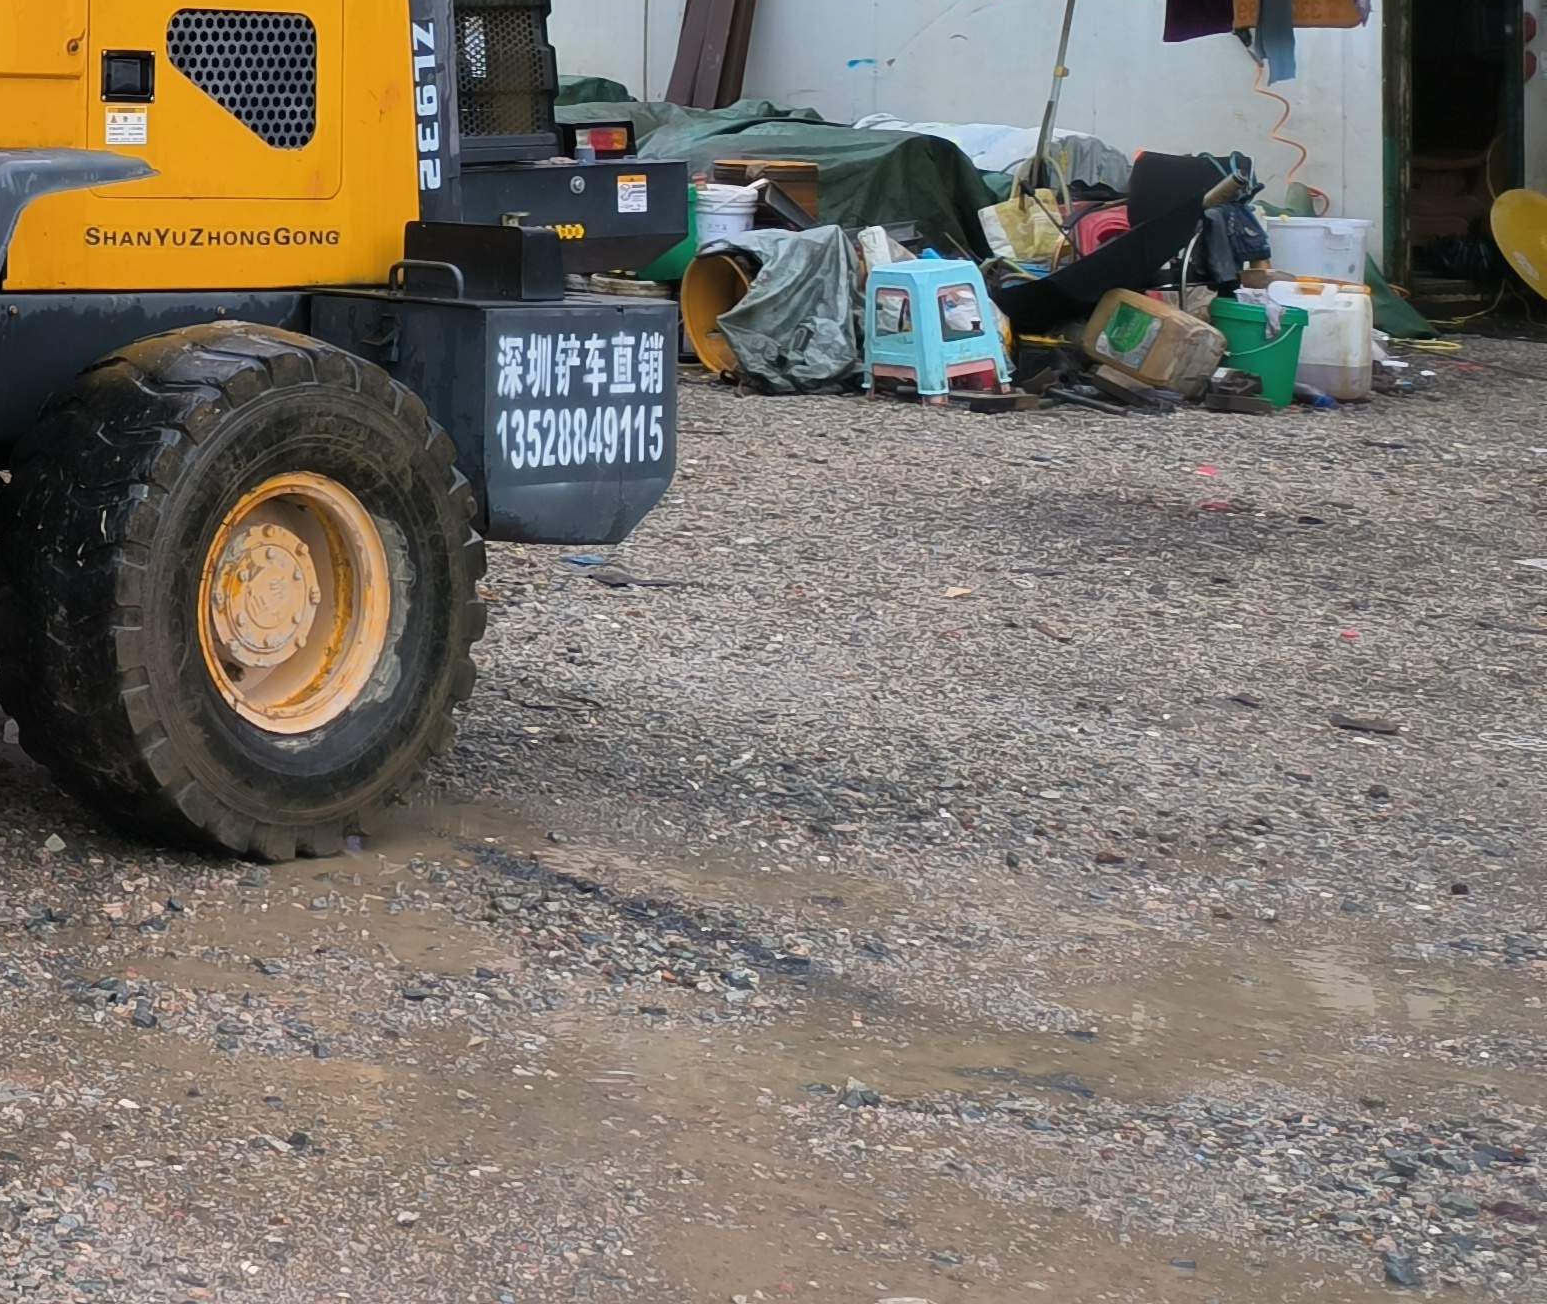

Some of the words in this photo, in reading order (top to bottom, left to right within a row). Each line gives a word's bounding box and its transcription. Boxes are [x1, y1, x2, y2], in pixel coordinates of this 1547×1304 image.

[411, 21, 442, 191] ZL932
[497, 331, 664, 399] 深圳铲车直销
[496, 404, 664, 469] 13528849115
